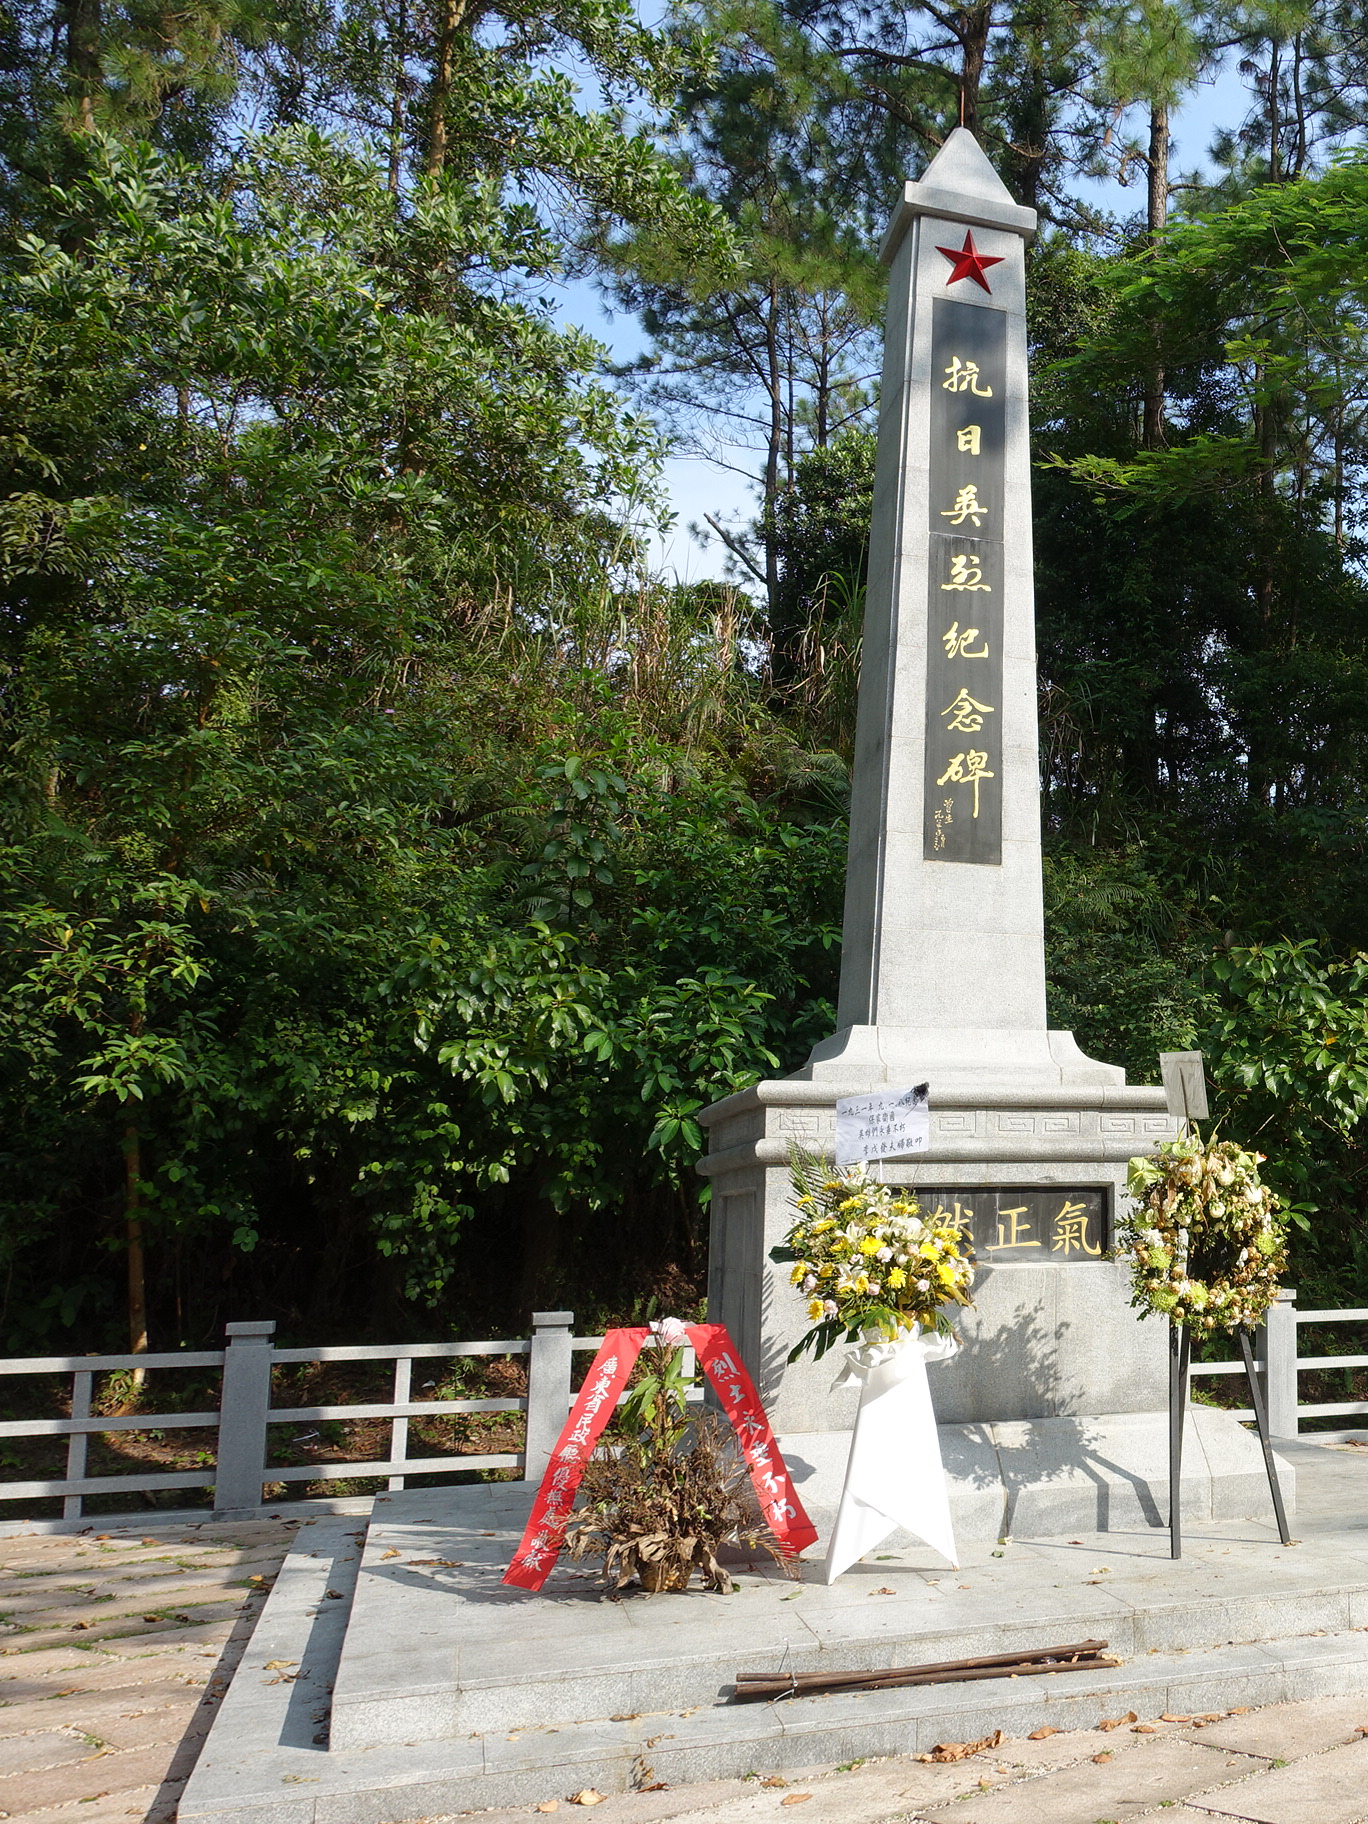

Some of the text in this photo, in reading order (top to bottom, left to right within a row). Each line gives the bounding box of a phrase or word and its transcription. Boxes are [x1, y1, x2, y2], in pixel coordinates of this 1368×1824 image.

[936, 355, 995, 819] 抗日英烈紀念碑
[932, 1200, 1102, 1257] 然正氣
[712, 1352, 797, 1522] 烈士永垂不朽
